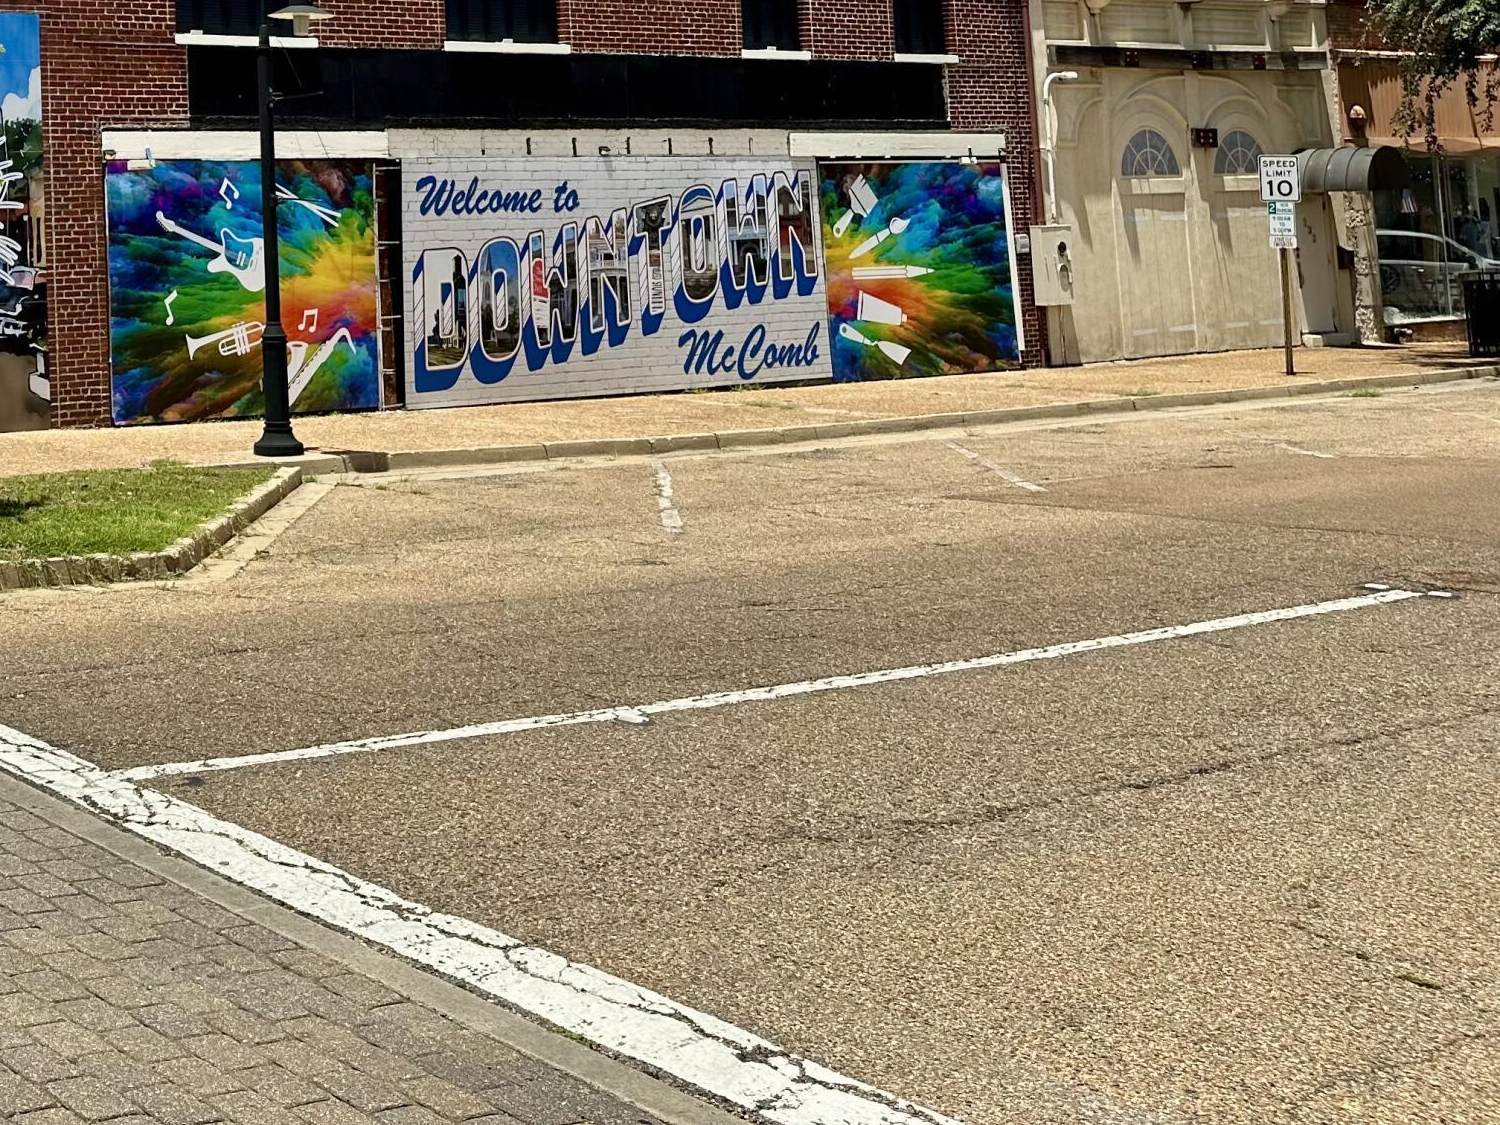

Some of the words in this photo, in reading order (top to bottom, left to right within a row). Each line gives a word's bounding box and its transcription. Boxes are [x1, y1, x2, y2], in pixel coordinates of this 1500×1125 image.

[1262, 160, 1296, 168] SPEED
[415, 175, 542, 217] Welcome
[553, 181, 580, 213] to
[1266, 179, 1293, 197] 10
[1269, 203, 1276, 213] 2
[416, 170, 818, 387] DOWNTOWN
[678, 322, 820, 380] McComb
